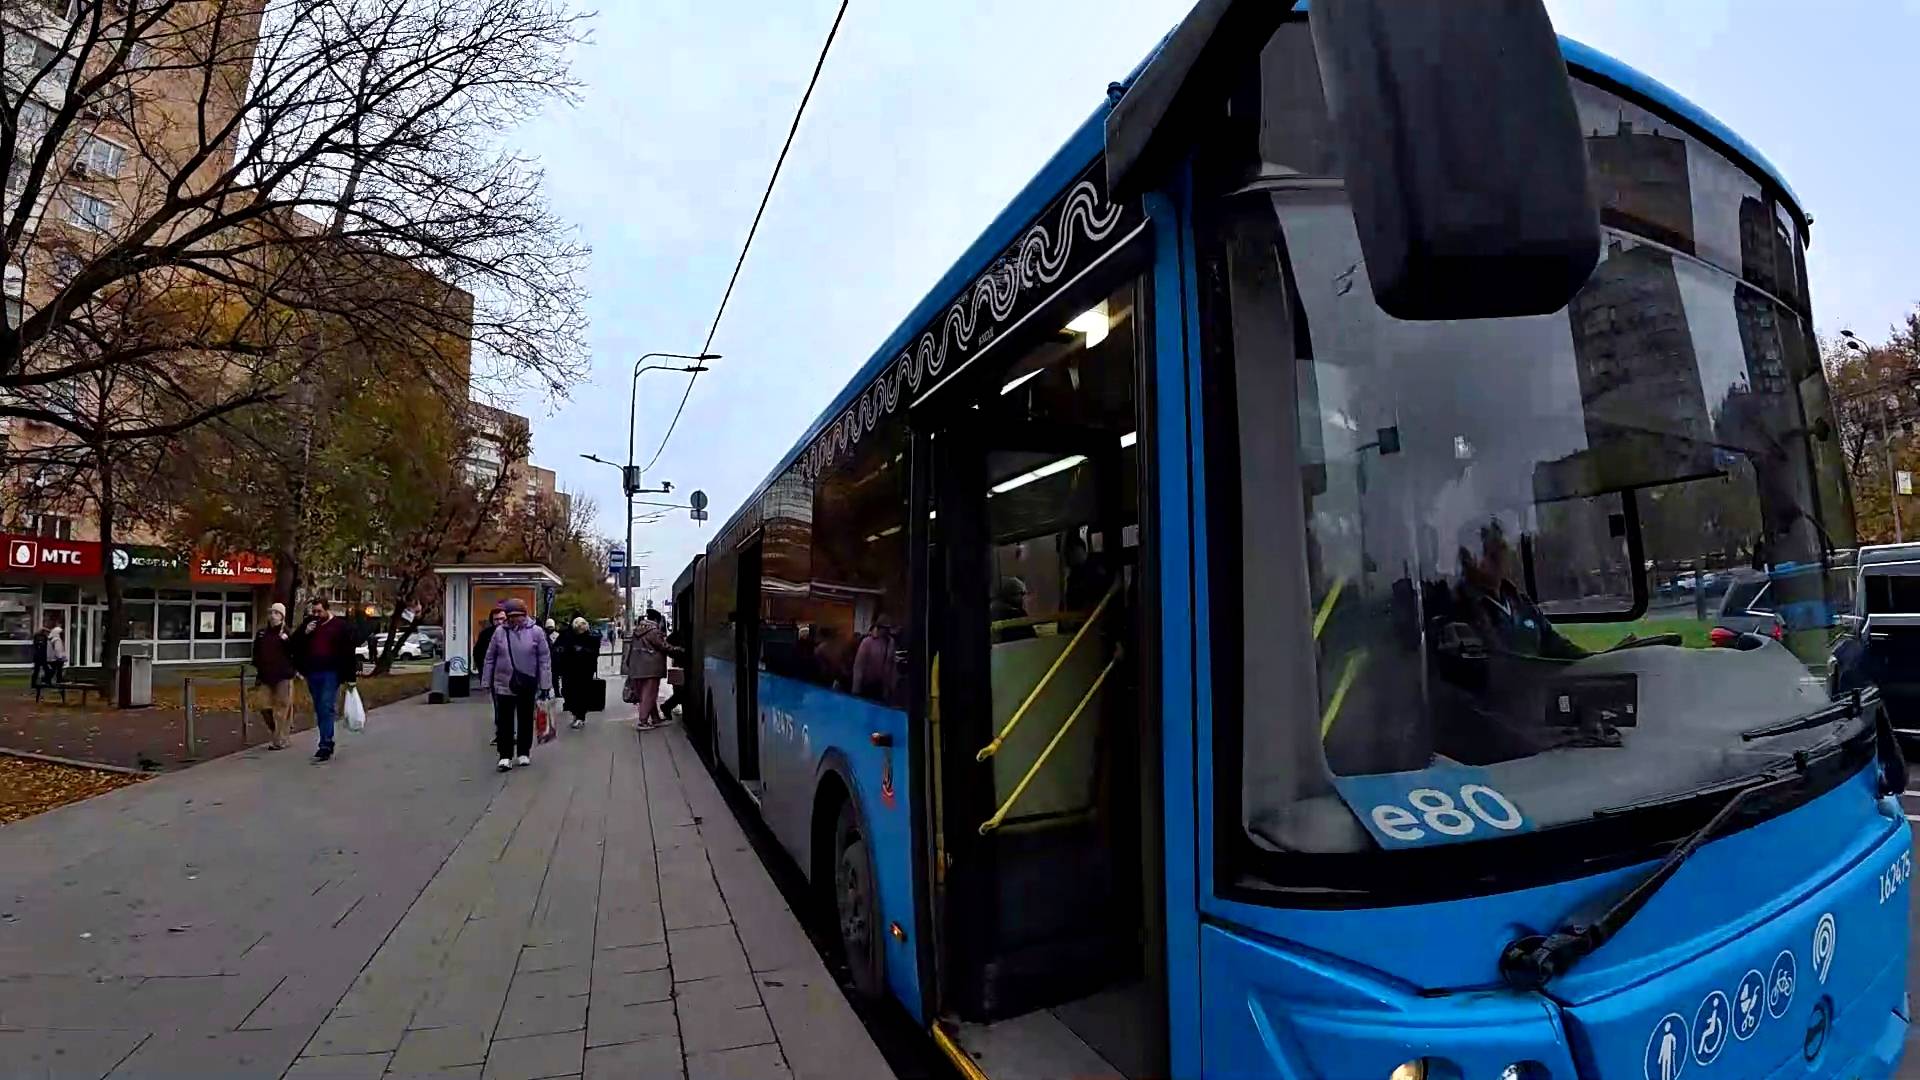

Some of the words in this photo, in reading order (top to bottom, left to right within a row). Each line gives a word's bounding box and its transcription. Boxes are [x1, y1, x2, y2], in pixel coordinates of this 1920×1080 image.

[42, 548, 81, 565] МТС
[201, 559, 229, 568] ЗАОГ
[1880, 849, 1911, 905] 162475
